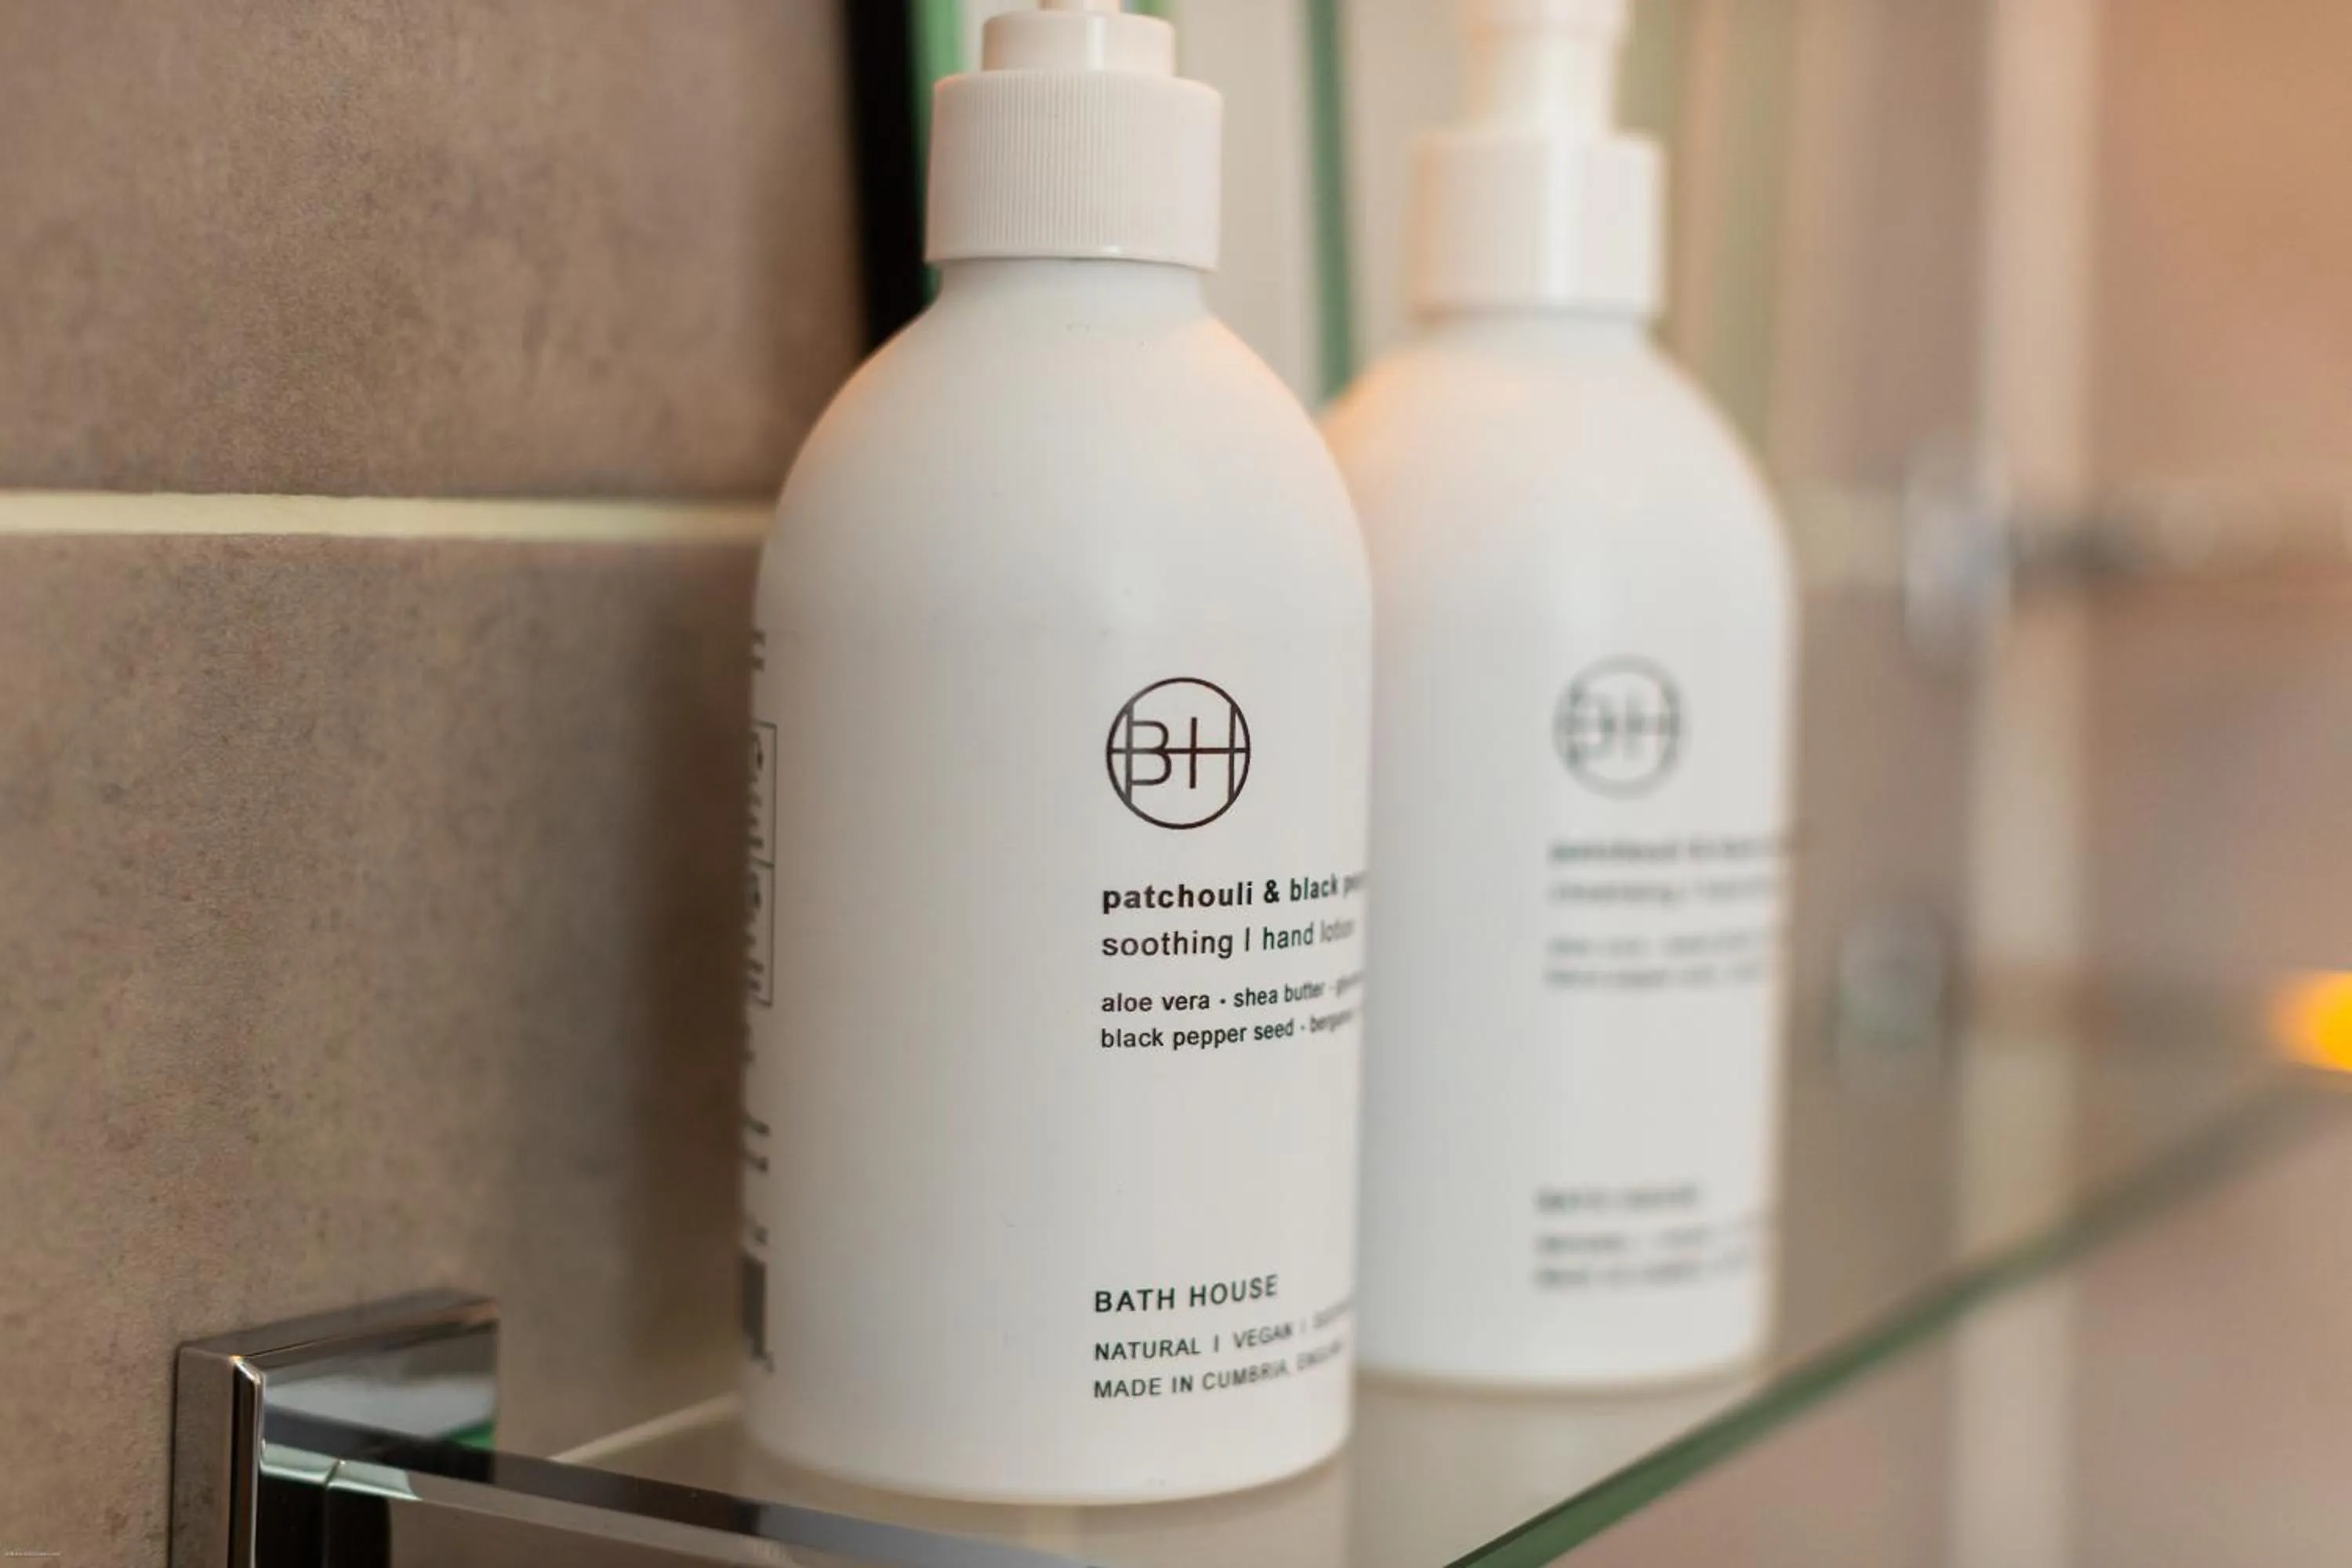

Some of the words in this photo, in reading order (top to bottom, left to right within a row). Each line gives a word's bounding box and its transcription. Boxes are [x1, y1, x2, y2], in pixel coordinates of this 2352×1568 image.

[1120, 700, 1240, 809] BH
[1102, 880, 1254, 916] patchouli
[1262, 878, 1280, 905] &
[1289, 873, 1339, 903] black
[1101, 929, 1234, 960] soothing
[1261, 921, 1315, 952] hand
[1100, 992, 1153, 1013] aloe
[1160, 993, 1210, 1012] vera
[1232, 986, 1279, 1008] shea
[1100, 1027, 1165, 1049] black
[1172, 1026, 1248, 1051] pepper
[1253, 1017, 1295, 1042] seed
[1094, 1287, 1175, 1314] BATH
[1188, 1273, 1278, 1308] HOUSE
[1093, 1337, 1202, 1362] NATURAL
[1232, 1322, 1294, 1350] VEGAN
[1093, 1377, 1163, 1399] MADE
[1171, 1374, 1194, 1394] IN
[1200, 1359, 1290, 1392] CUMBRIA
